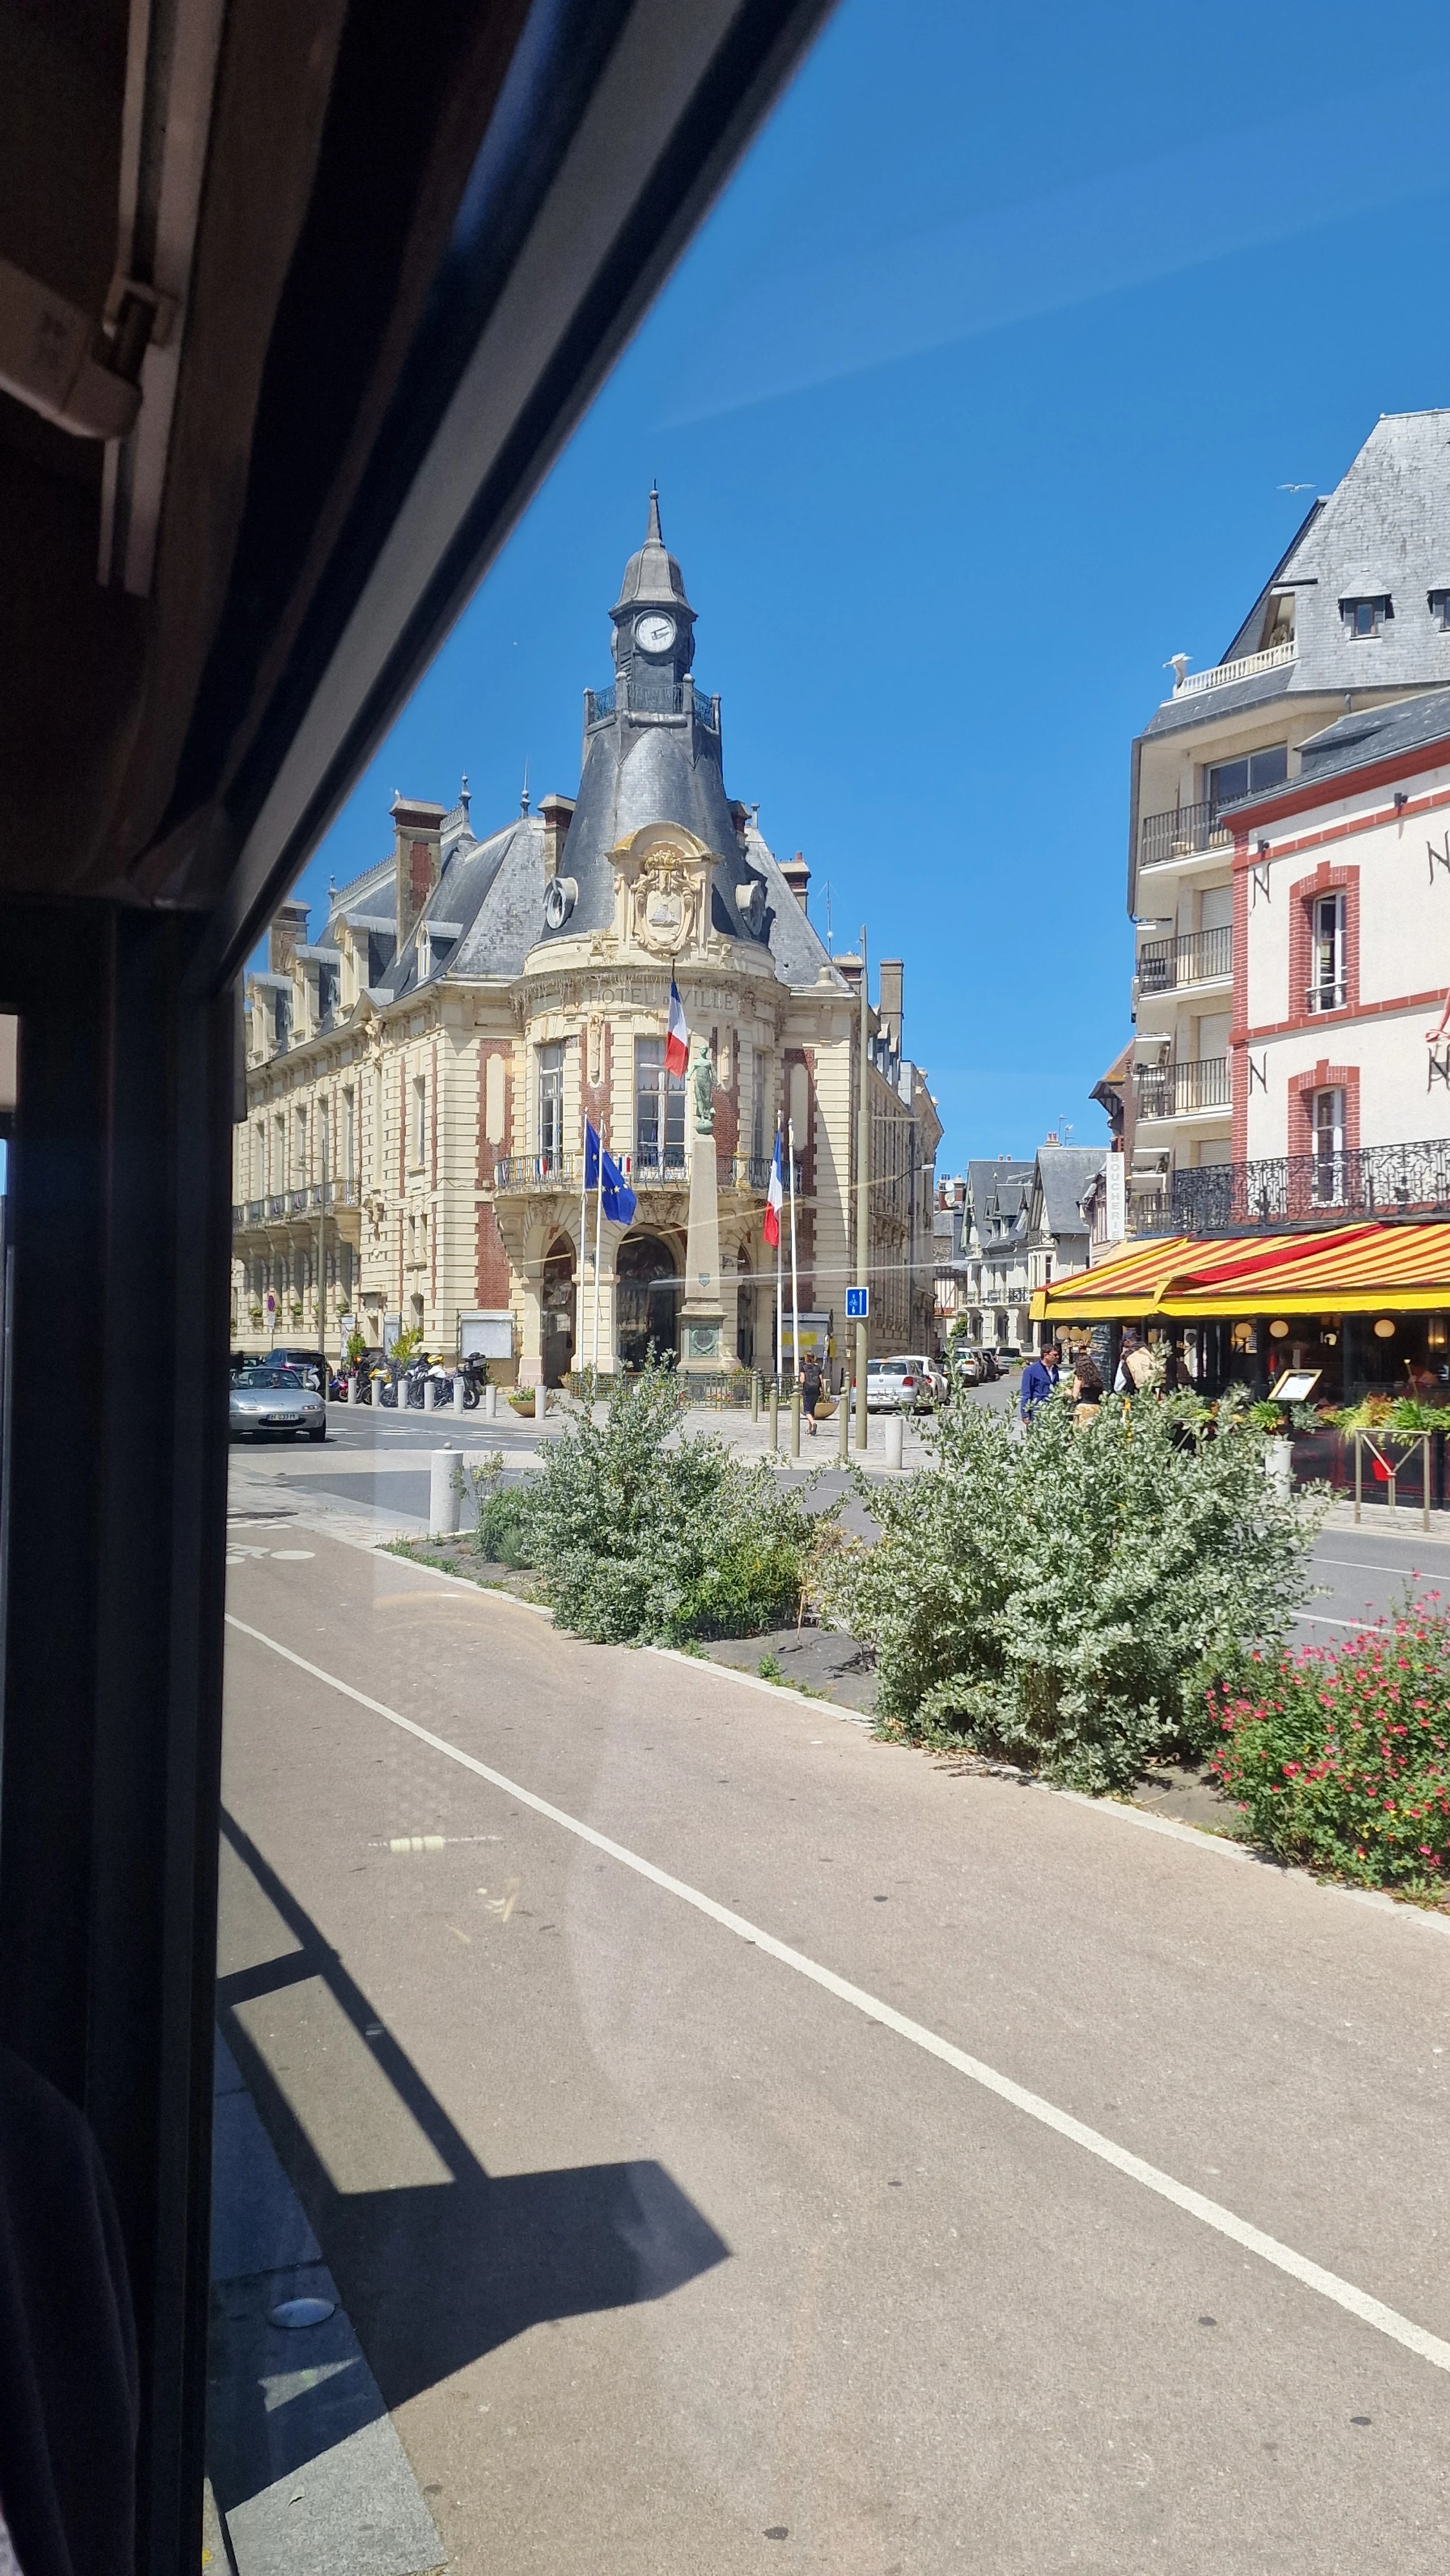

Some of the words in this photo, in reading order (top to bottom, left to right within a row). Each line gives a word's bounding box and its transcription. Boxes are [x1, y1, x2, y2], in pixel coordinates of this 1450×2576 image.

[588, 988, 656, 1005] HOTEL
[678, 990, 734, 1010] VILLE
[1111, 1154, 1120, 1239] BOUCHERIE
